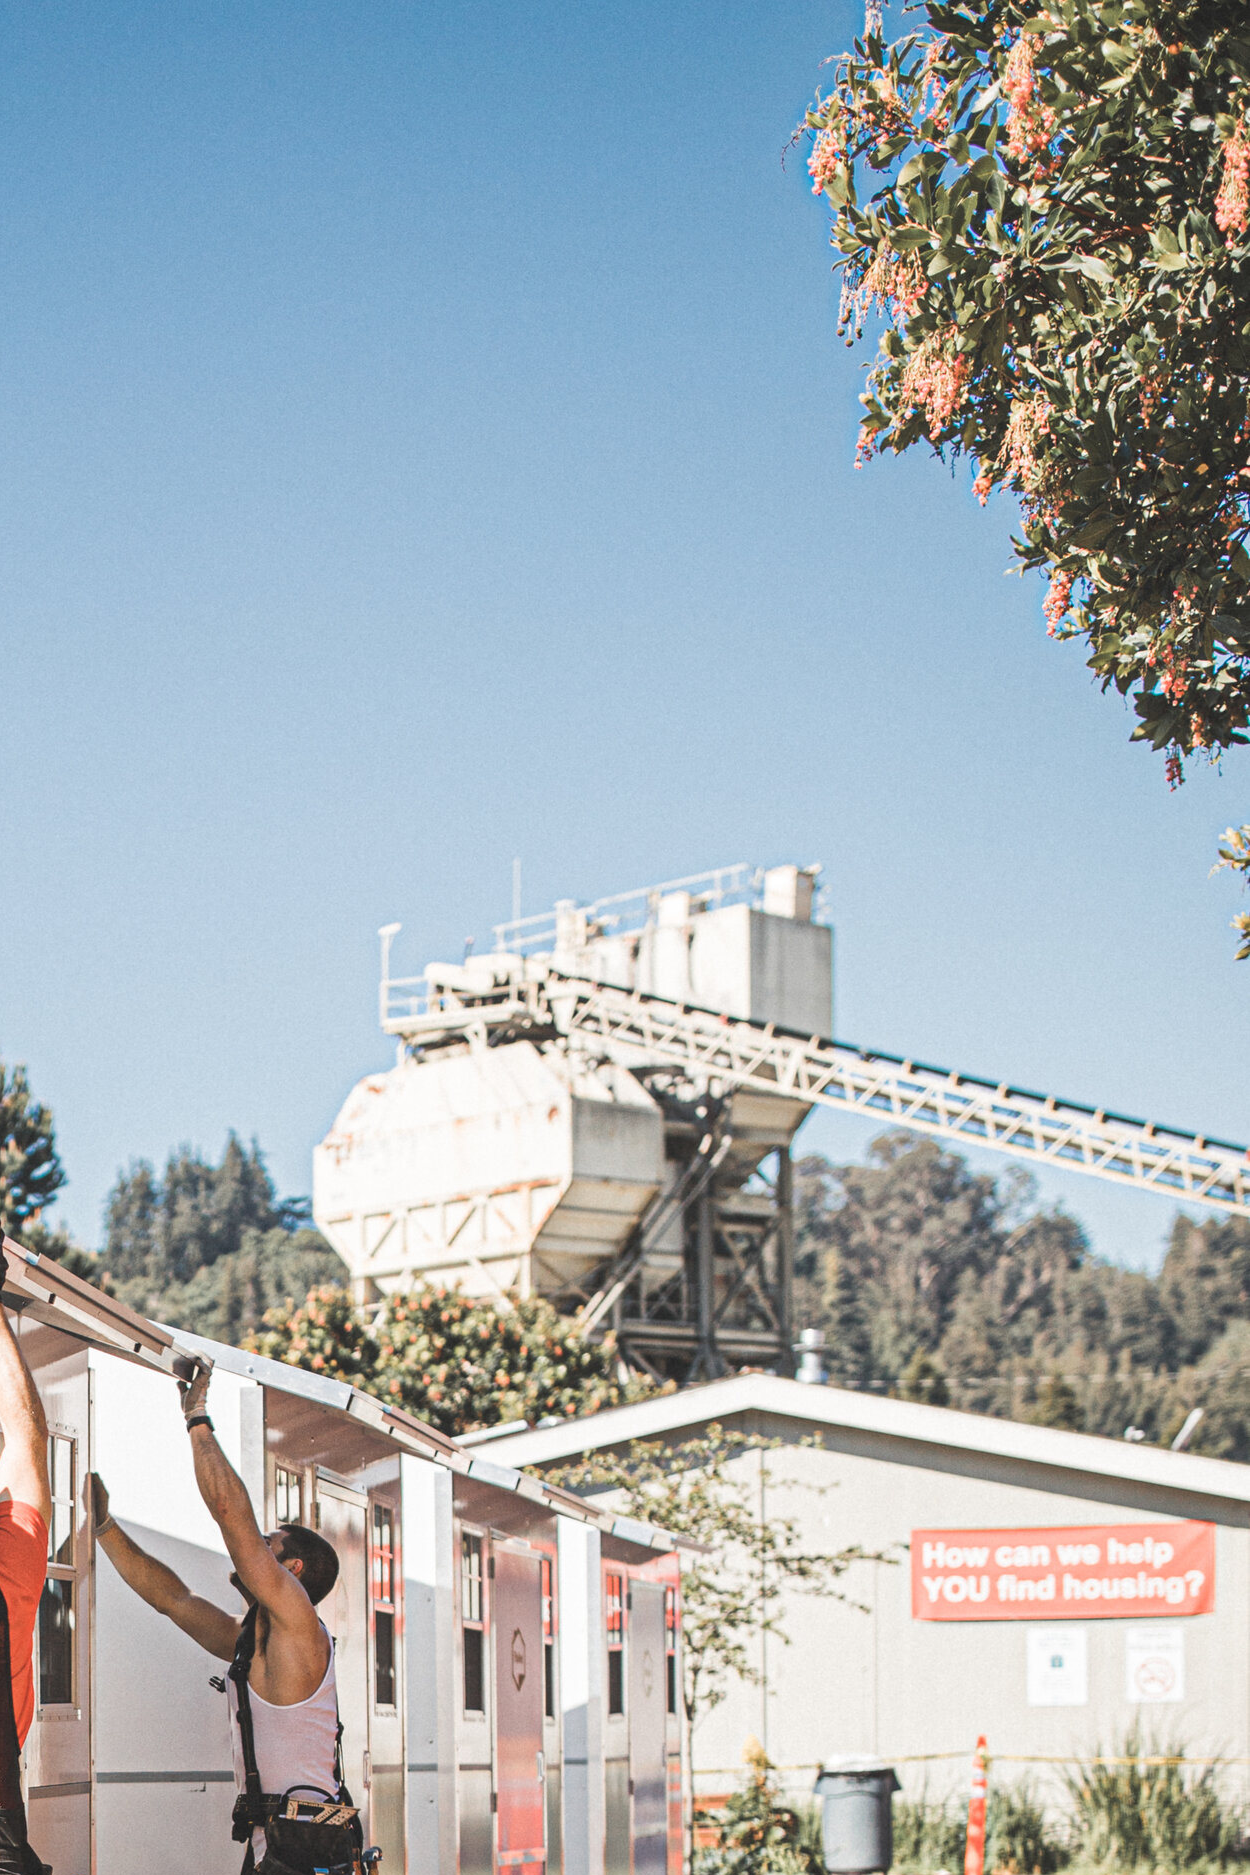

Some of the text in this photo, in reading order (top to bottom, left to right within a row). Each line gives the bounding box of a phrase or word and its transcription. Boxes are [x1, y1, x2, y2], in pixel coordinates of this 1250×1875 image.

[922, 1537, 1174, 1569] How can we help
[922, 1570, 1206, 1604] YOU find housing?
